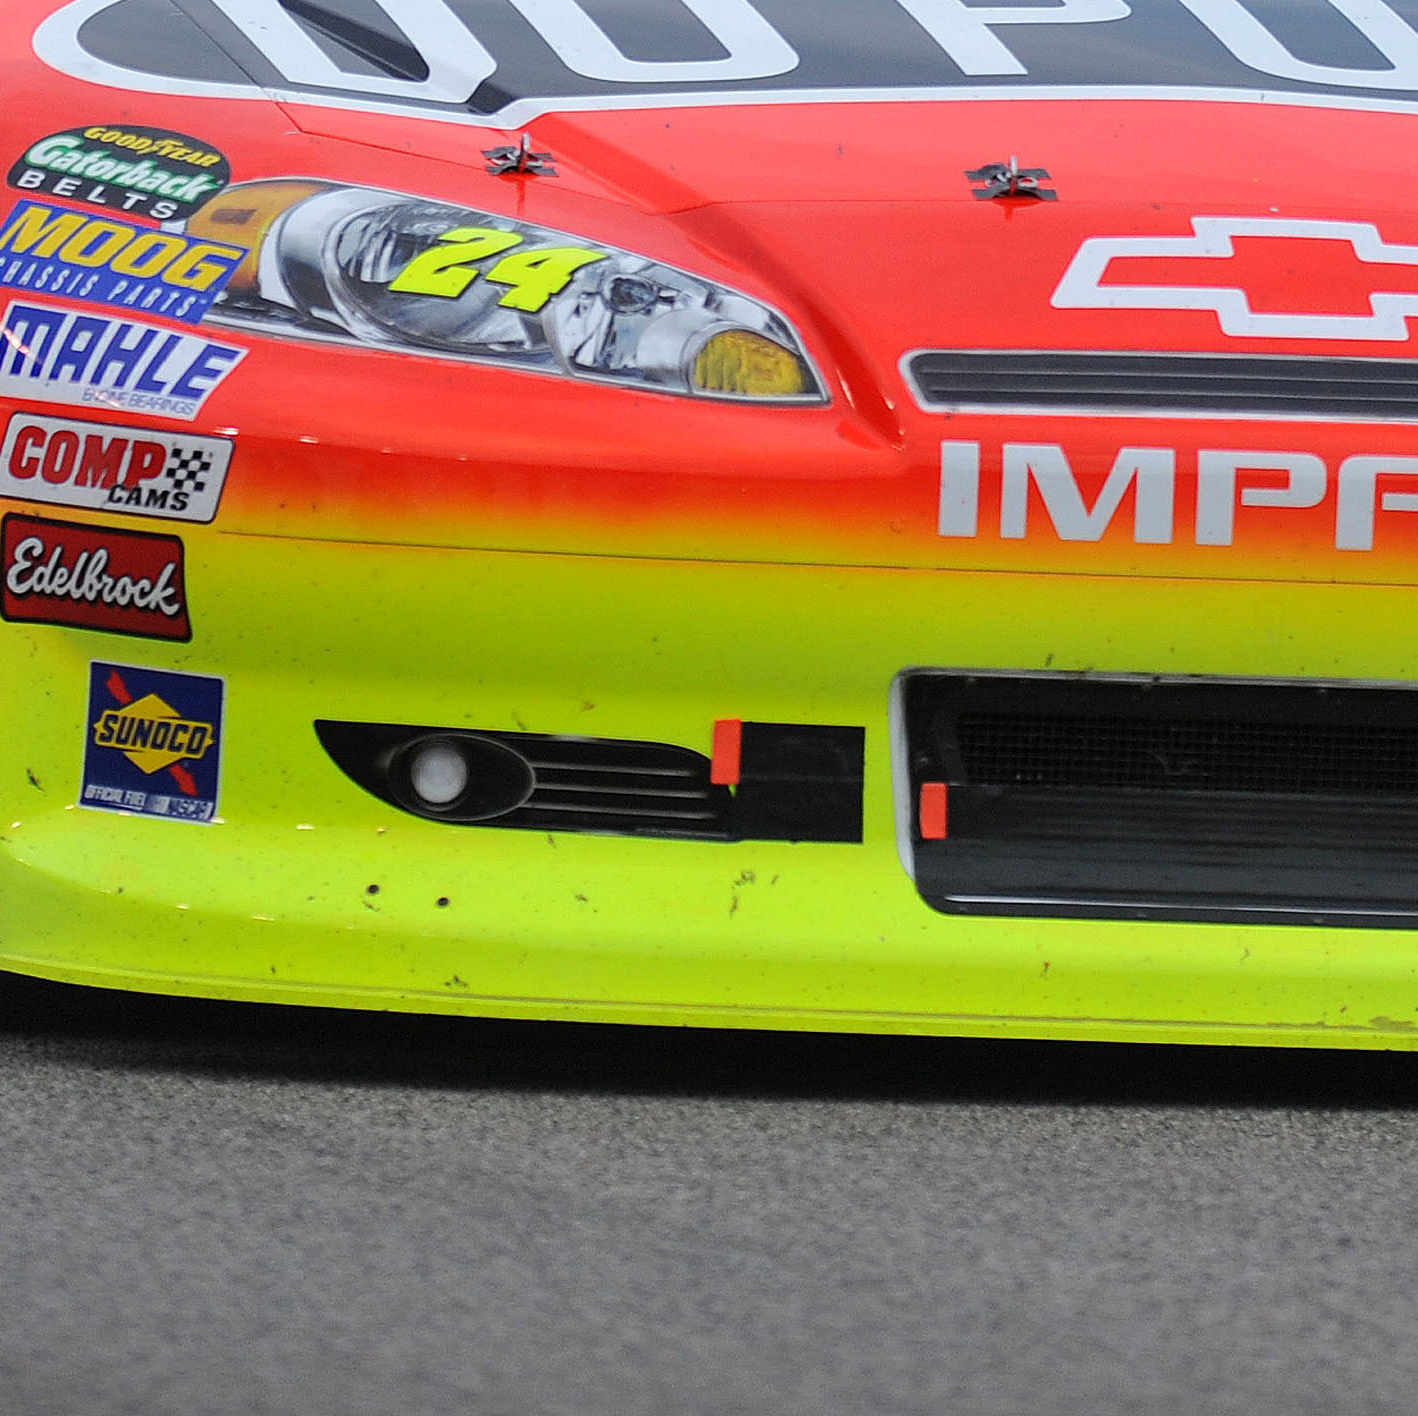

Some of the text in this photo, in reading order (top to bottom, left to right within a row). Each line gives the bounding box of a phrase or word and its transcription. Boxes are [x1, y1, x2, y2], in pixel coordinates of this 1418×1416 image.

[25, 134, 218, 203] Gatorback
[83, 126, 222, 168] GOODYEAR
[16, 169, 180, 220] BELTS
[388, 227, 609, 313] 24
[107, 279, 197, 318] PARTS
[82, 387, 196, 417] ENGINE BEARINGS
[8, 425, 167, 491] COMP
[107, 483, 191, 512] CAMS
[6, 536, 180, 616] Edelbrock
[98, 713, 208, 755] SUNOCO
